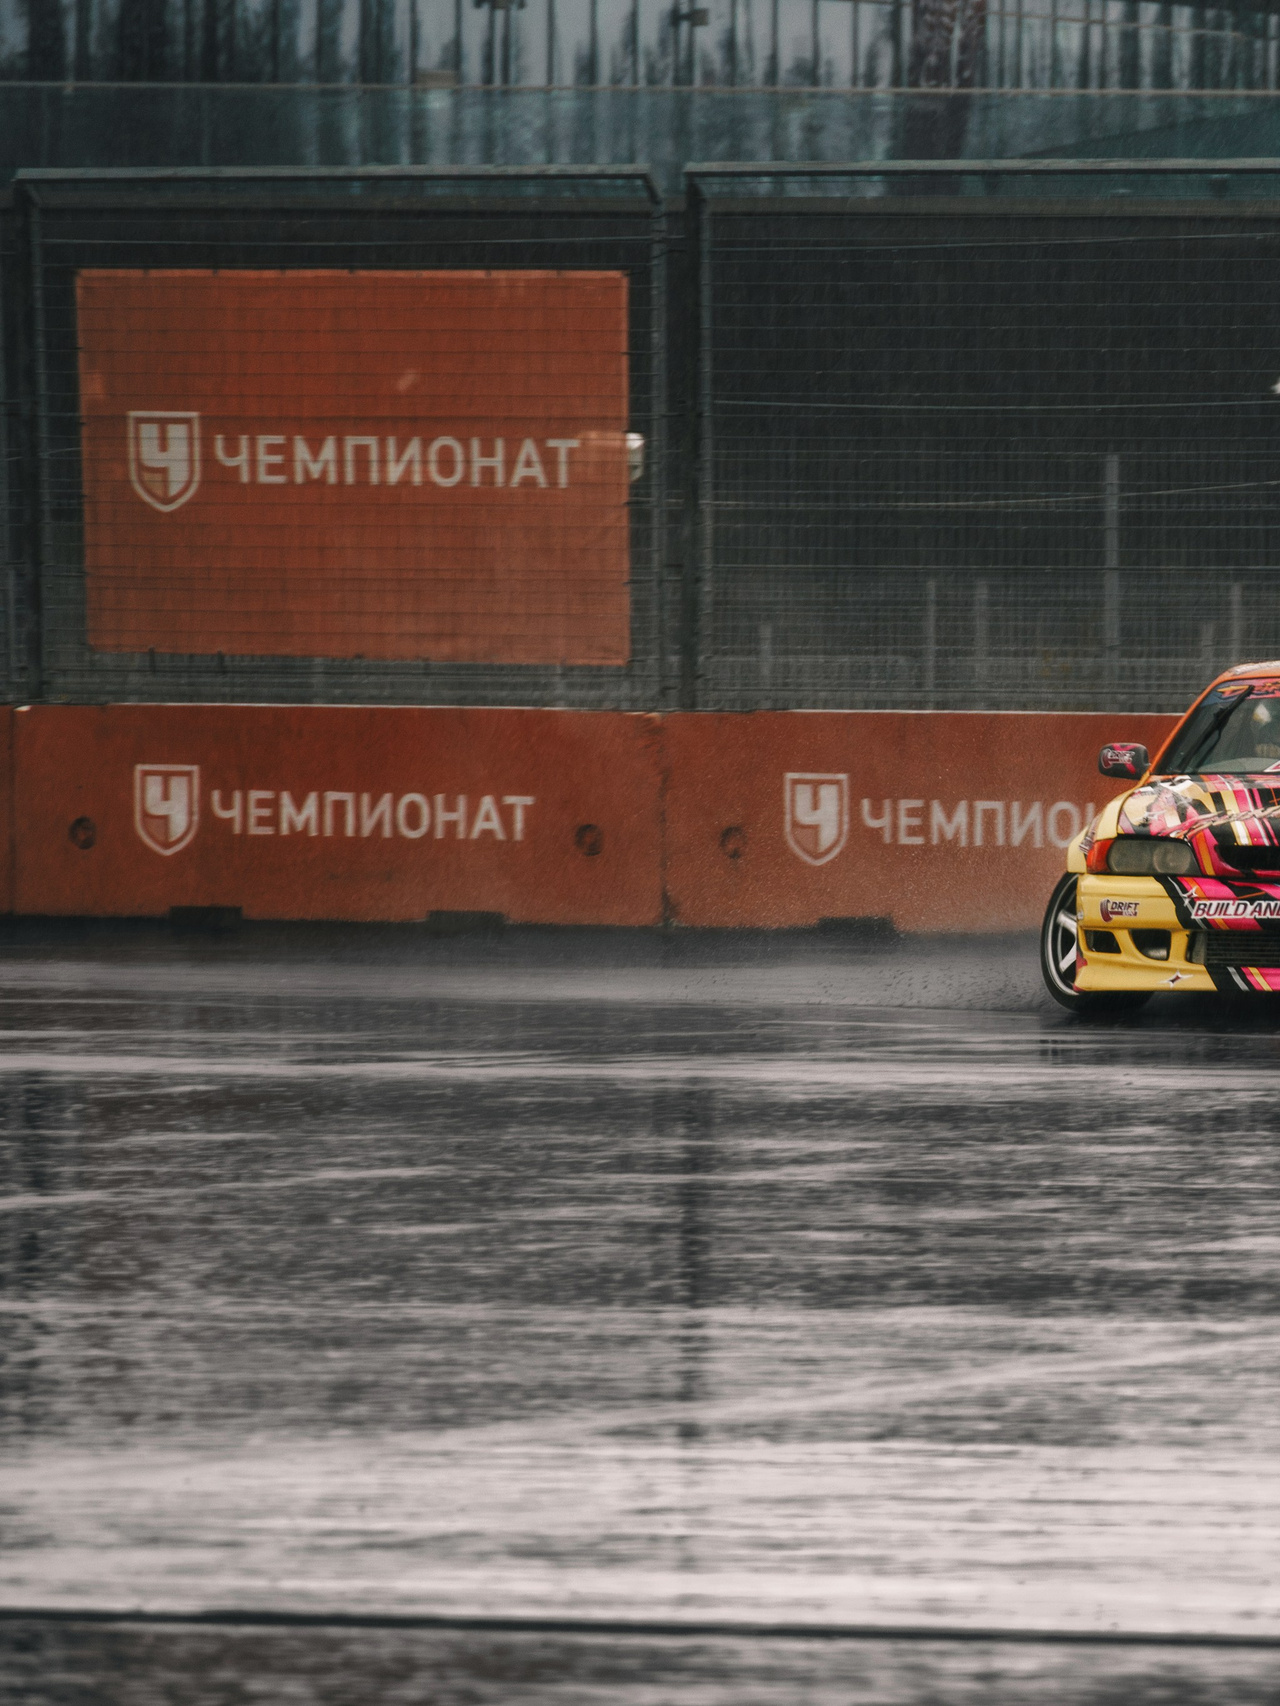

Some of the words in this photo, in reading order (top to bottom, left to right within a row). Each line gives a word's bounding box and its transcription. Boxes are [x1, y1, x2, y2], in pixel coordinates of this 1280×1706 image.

[213, 434, 580, 489] ЧЕМПИОНАТ
[210, 788, 536, 842] ЧЕМПИОНАТ
[1110, 901, 1140, 911] DRIFT
[1194, 902, 1248, 917] BUILD
